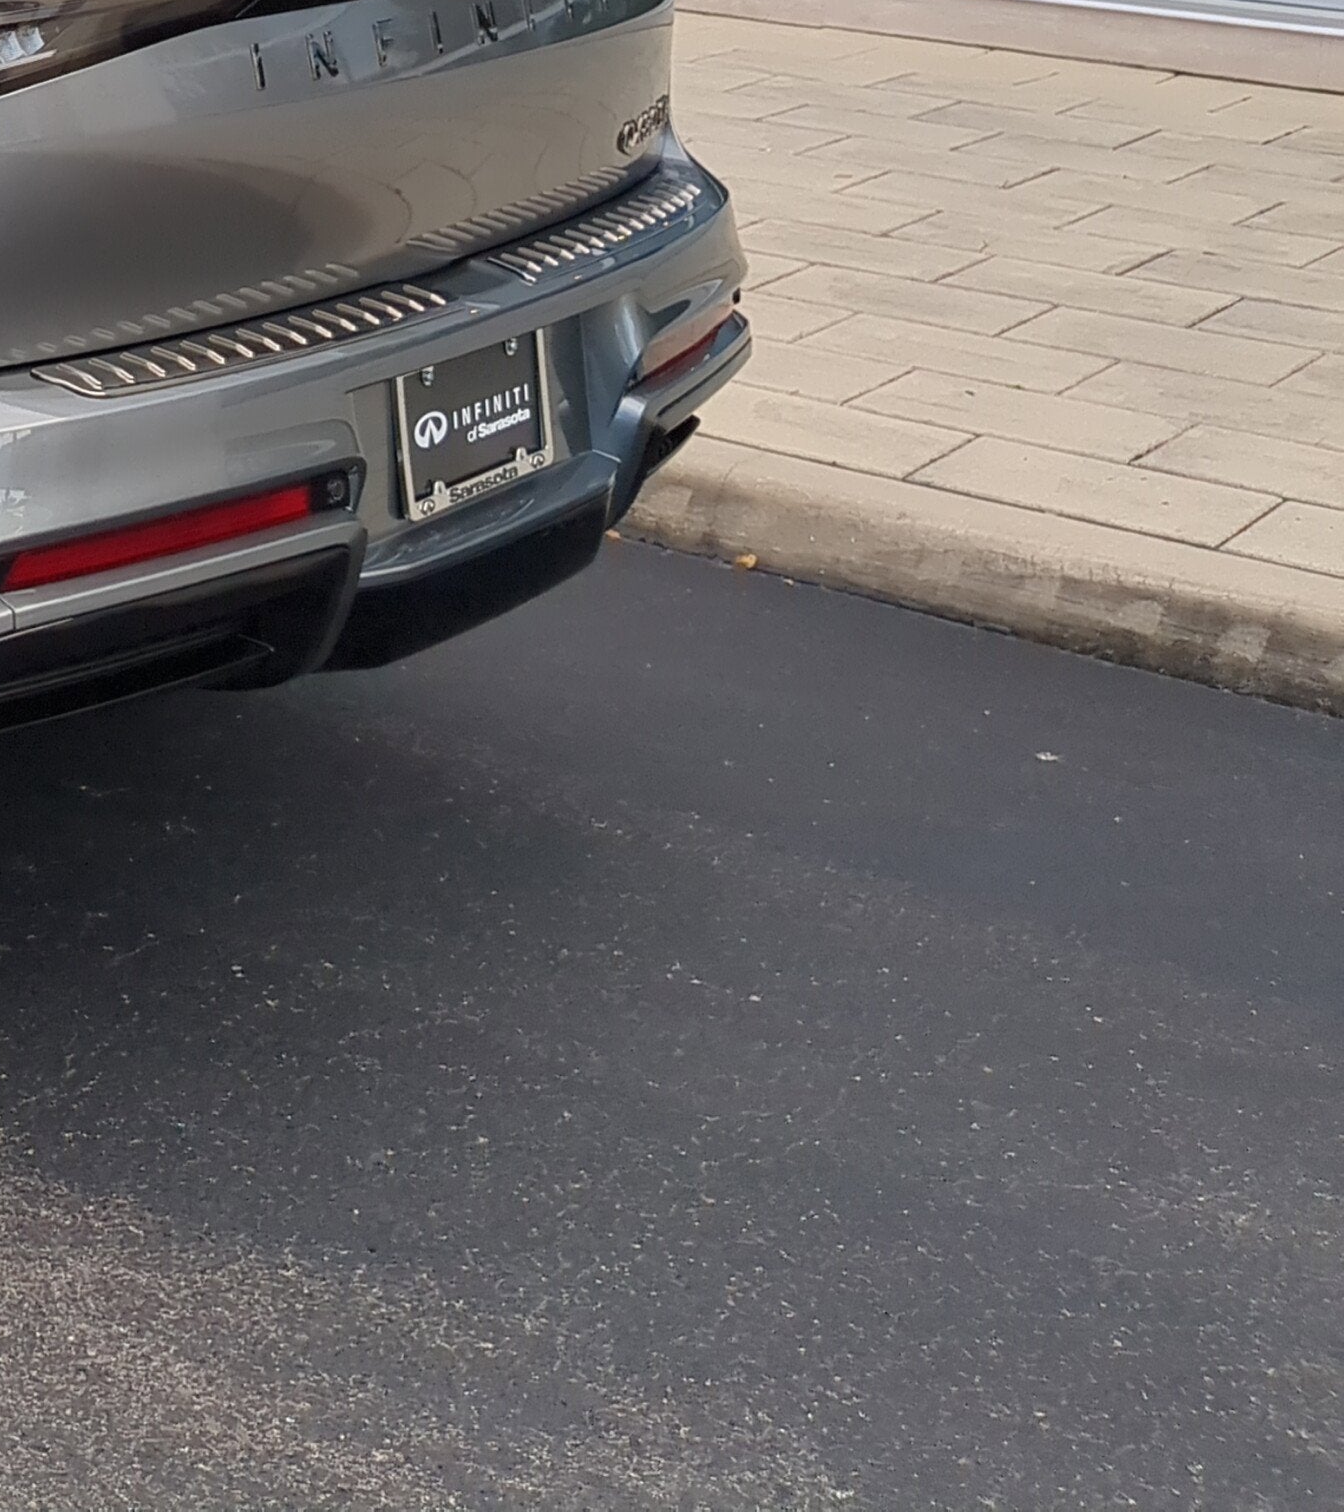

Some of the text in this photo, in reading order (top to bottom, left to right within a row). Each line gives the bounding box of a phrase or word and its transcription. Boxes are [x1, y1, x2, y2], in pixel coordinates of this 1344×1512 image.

[453, 383, 530, 430] INFINITI
[467, 408, 531, 443] of Sarasota
[449, 464, 518, 504] Sarasota
